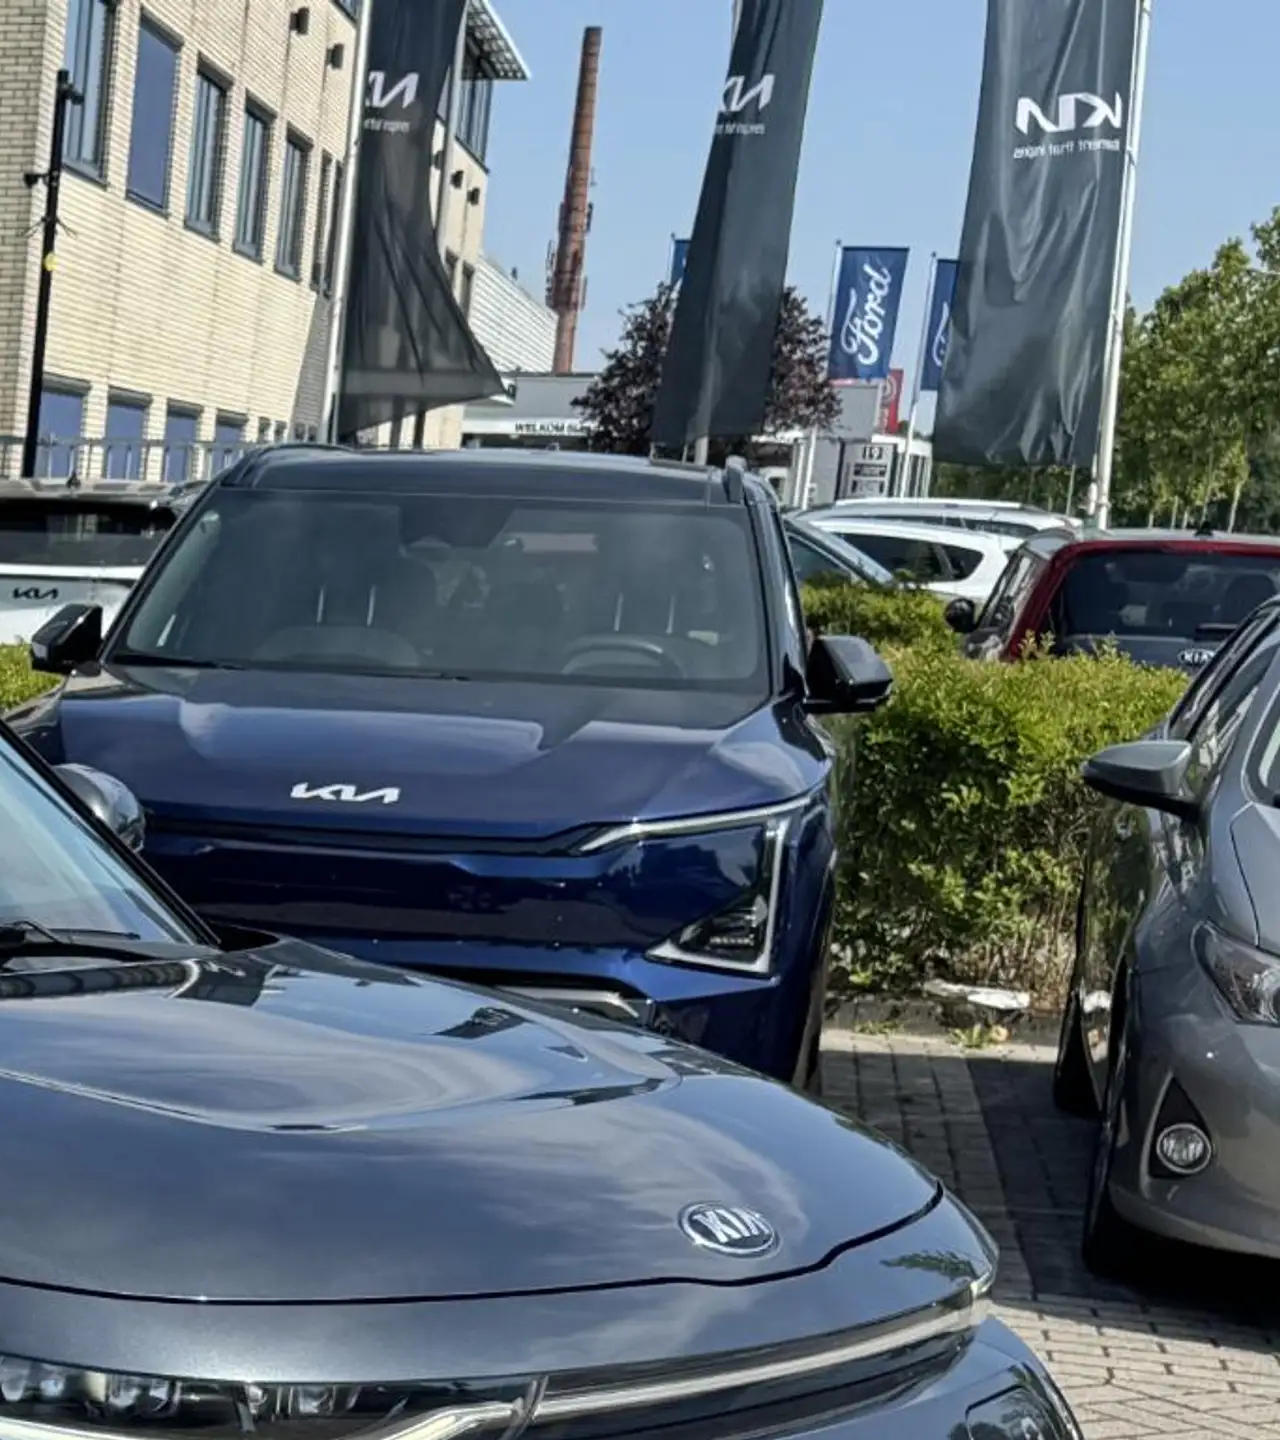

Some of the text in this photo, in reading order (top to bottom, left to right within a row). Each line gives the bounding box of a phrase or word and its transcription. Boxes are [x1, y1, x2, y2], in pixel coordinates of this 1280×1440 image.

[841, 262, 892, 365] Ford
[13, 586, 59, 600] KIA
[290, 782, 400, 804] KIA
[692, 1207, 771, 1243] KIA
